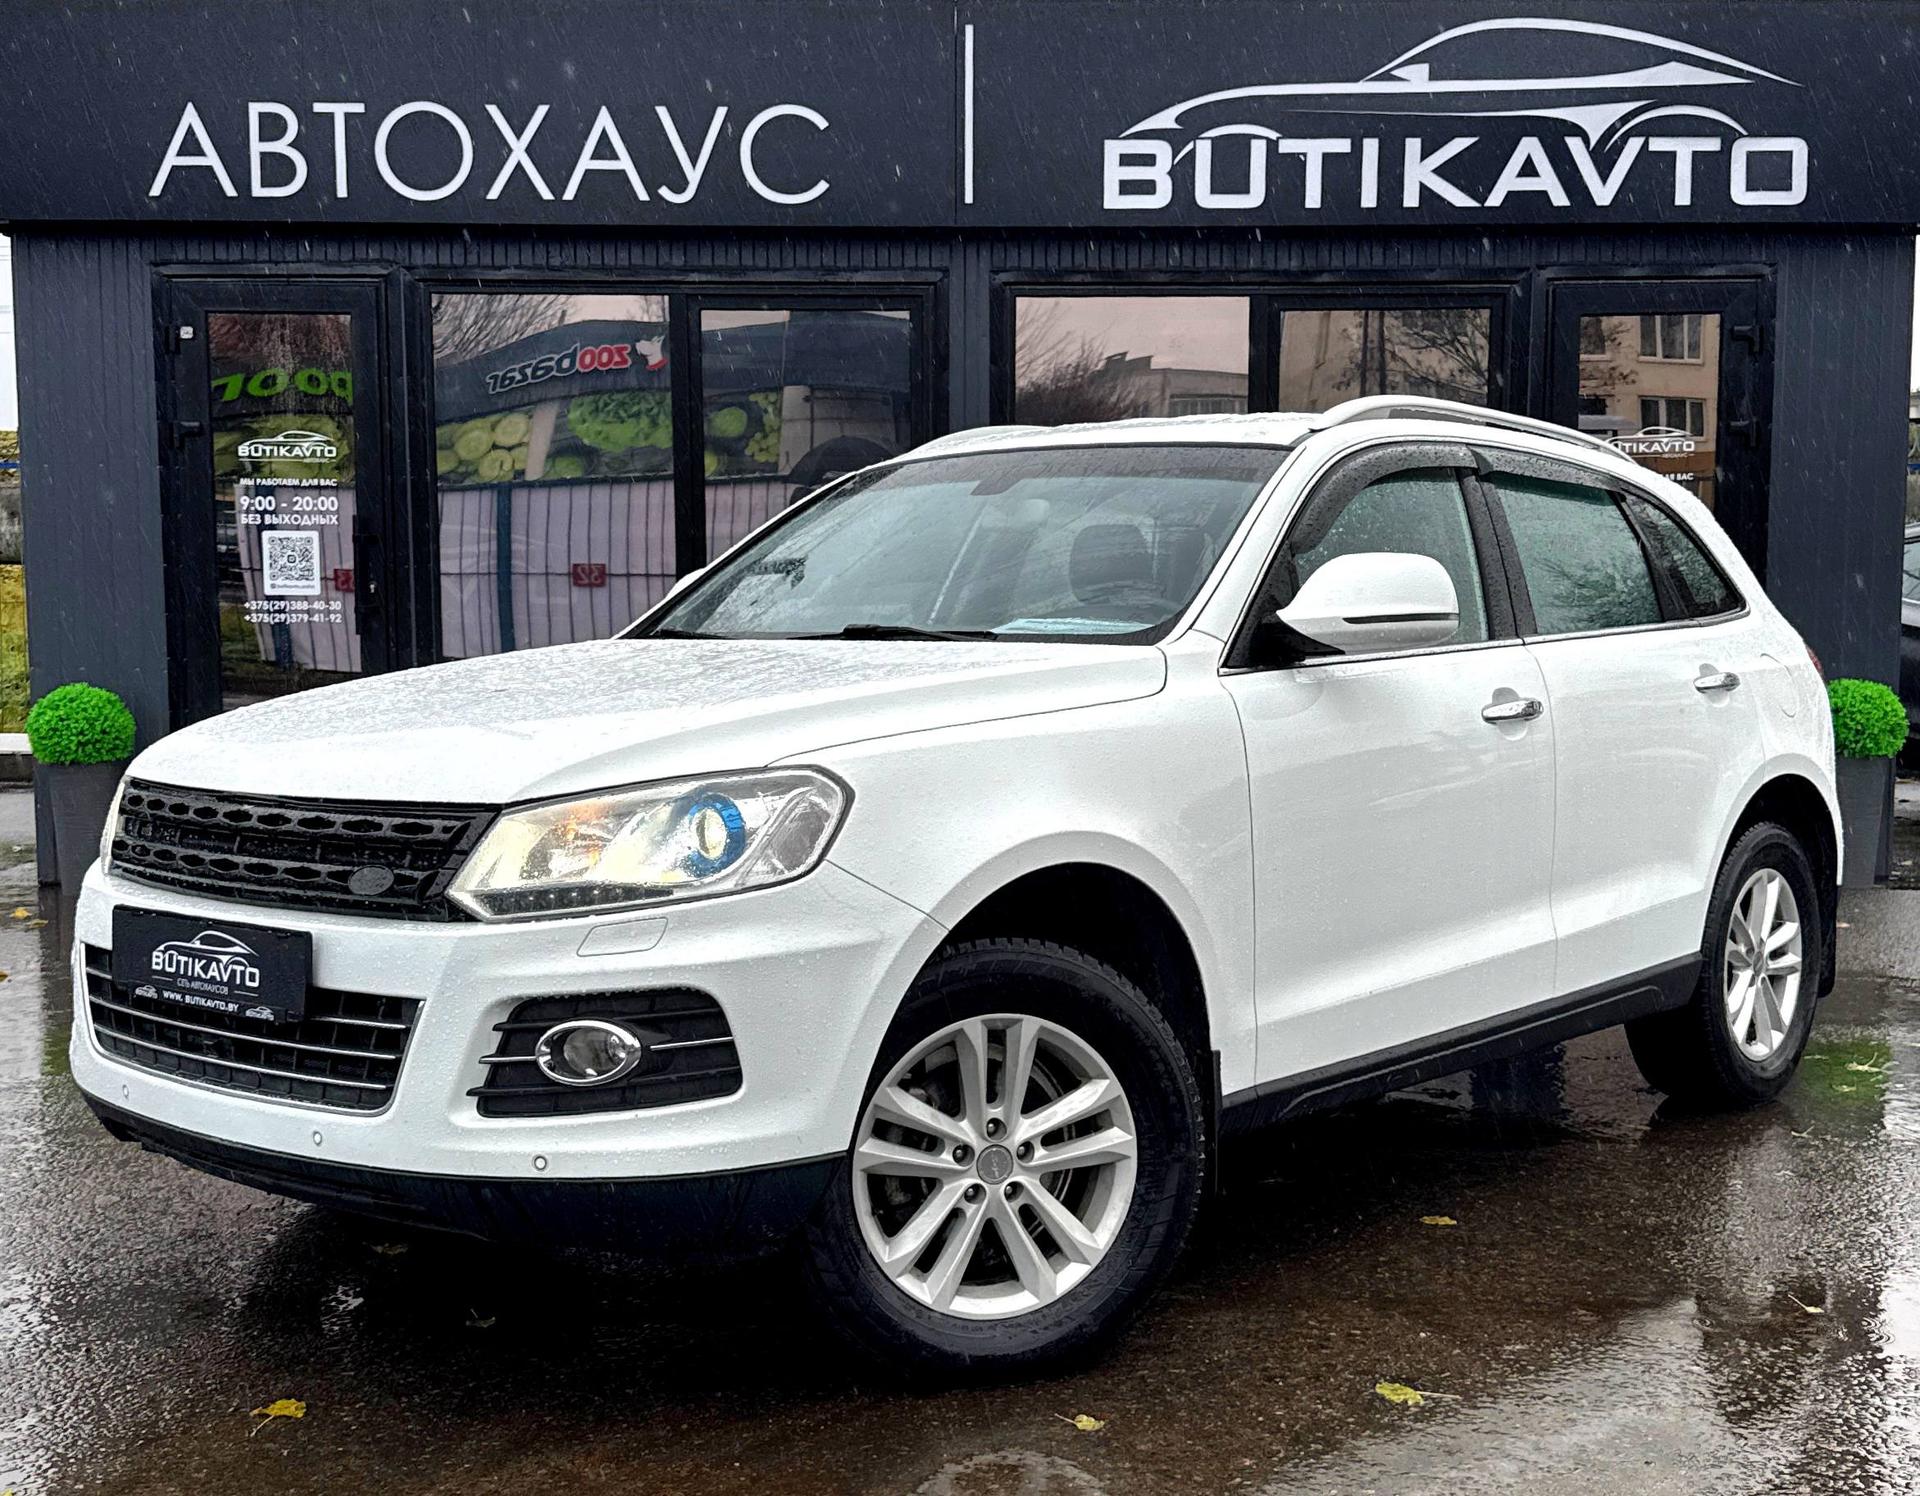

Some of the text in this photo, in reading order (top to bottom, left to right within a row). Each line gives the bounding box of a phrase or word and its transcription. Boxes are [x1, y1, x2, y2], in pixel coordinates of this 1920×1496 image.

[149, 101, 830, 205] АВТОХАУС
[1103, 136, 1809, 209] BUTIKAVTO
[237, 445, 337, 457] BUTIKAVTO
[1611, 441, 1695, 453] TIKAVTO
[240, 478, 338, 487] МЫ РАБОТАЕМ ДЛЯ ВАС
[240, 496, 276, 511] 9:00
[292, 496, 339, 511] 20:00
[241, 514, 339, 526] БЕЗ ВЫХОДНЫХ
[243, 600, 342, 612] +375(29)388-40-30
[243, 613, 343, 625] +375(29)379-41-92
[151, 949, 260, 988] BUTIKAVTO
